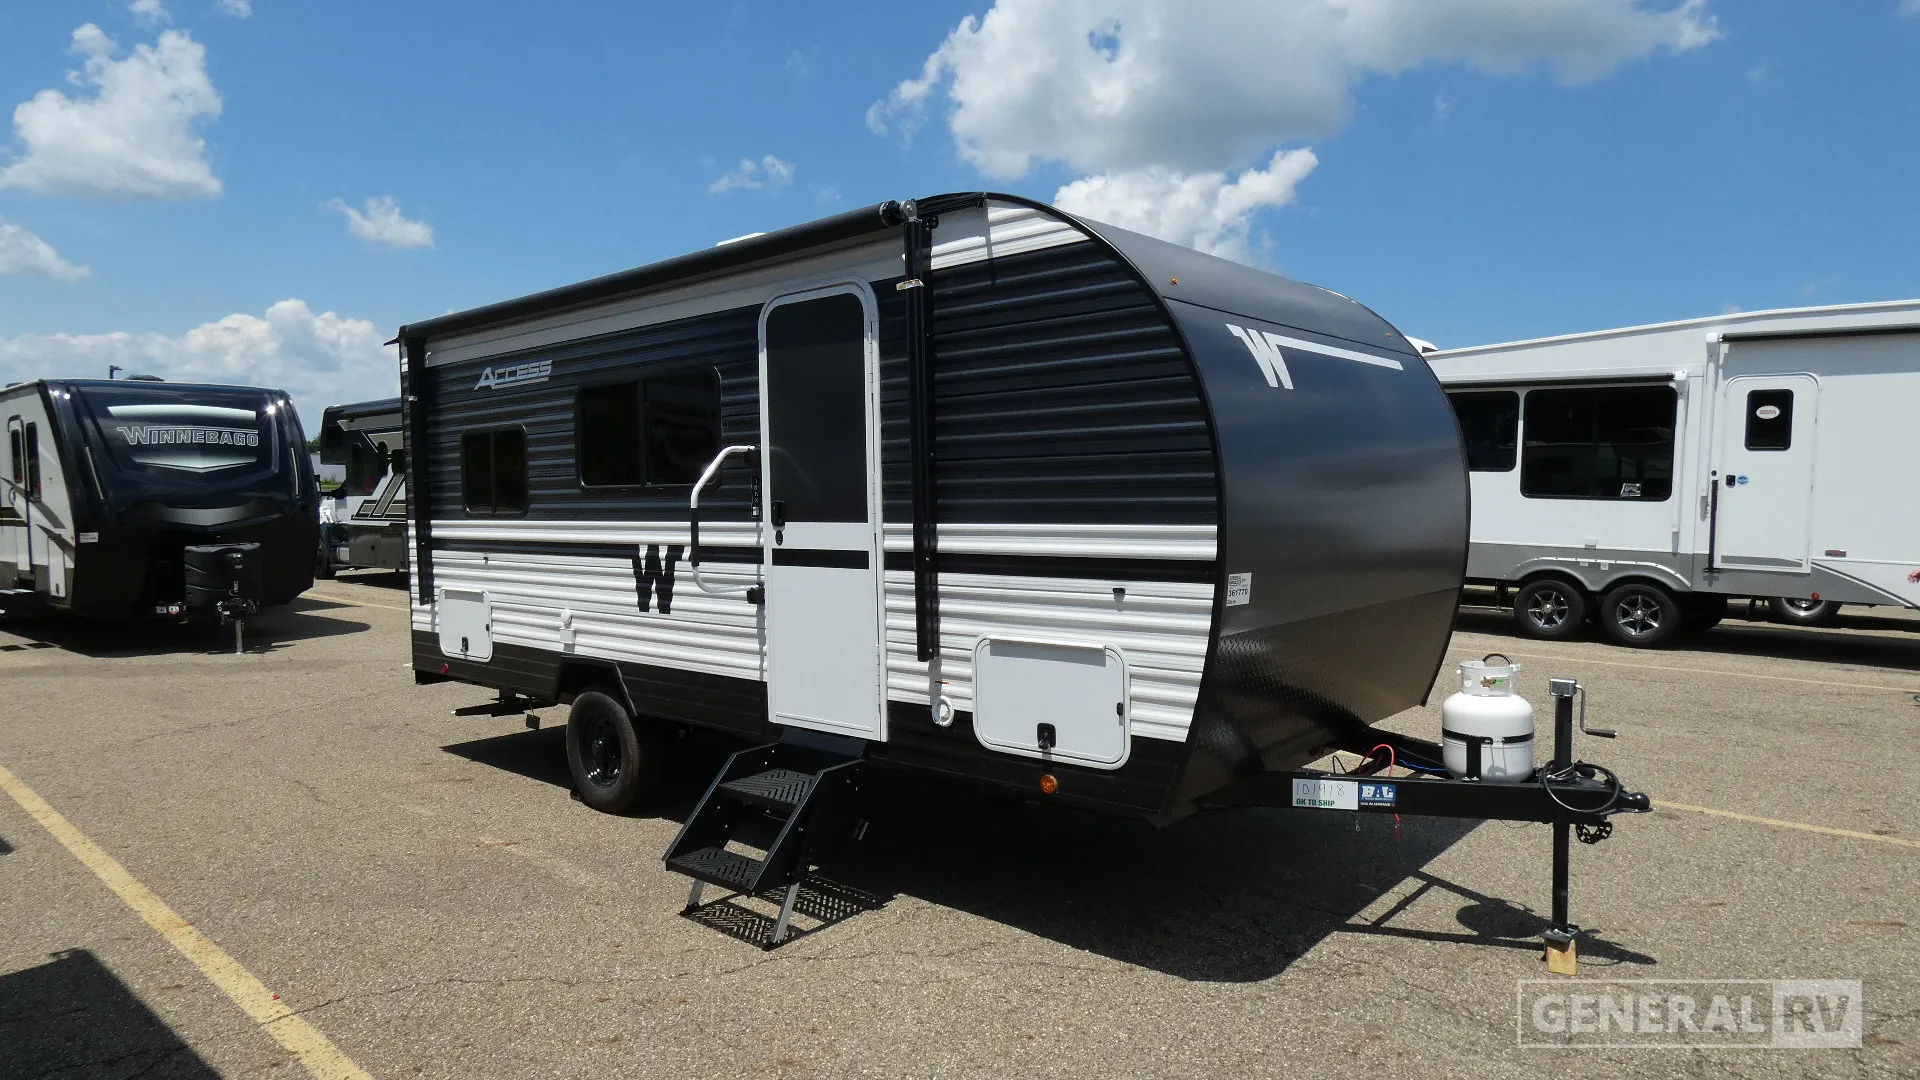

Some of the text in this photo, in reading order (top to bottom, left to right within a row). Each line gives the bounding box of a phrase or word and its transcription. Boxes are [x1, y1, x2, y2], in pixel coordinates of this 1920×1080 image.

[474, 360, 553, 390] ACCESS
[117, 426, 258, 446] WINNEBAGO
[1296, 798, 1306, 806] OK
[1318, 799, 1336, 807] SHIP
